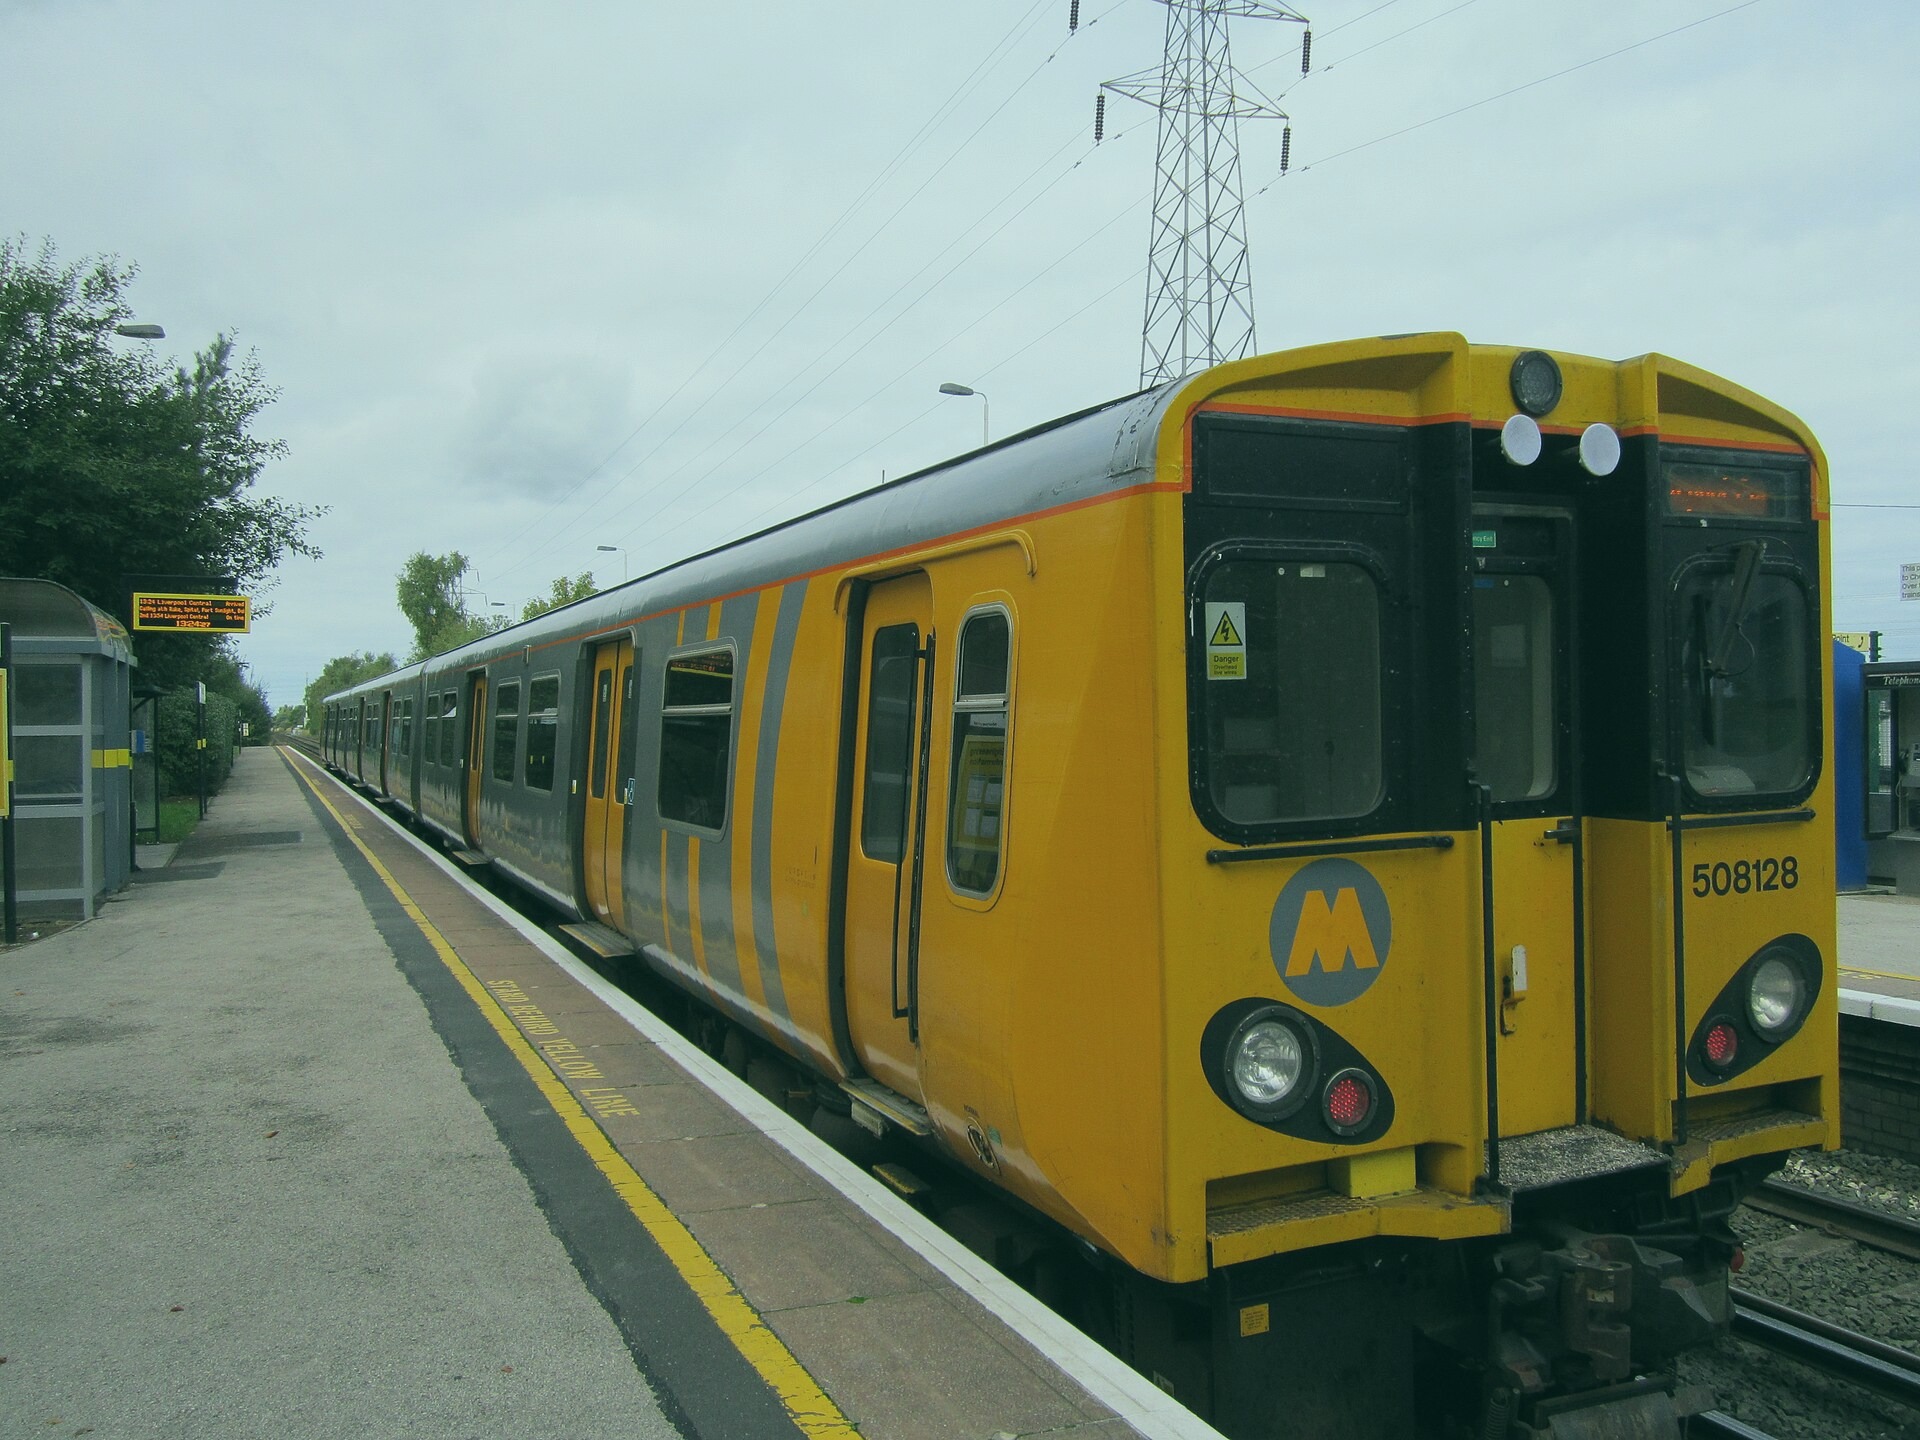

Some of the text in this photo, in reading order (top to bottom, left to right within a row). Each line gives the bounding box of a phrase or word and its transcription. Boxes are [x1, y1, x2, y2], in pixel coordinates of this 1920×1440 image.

[1213, 655, 1239, 664] Danger
[1692, 856, 1799, 898] 508128
[1284, 887, 1380, 977] M
[487, 980, 641, 1118] STAND BEHIND YELLOW LINE
